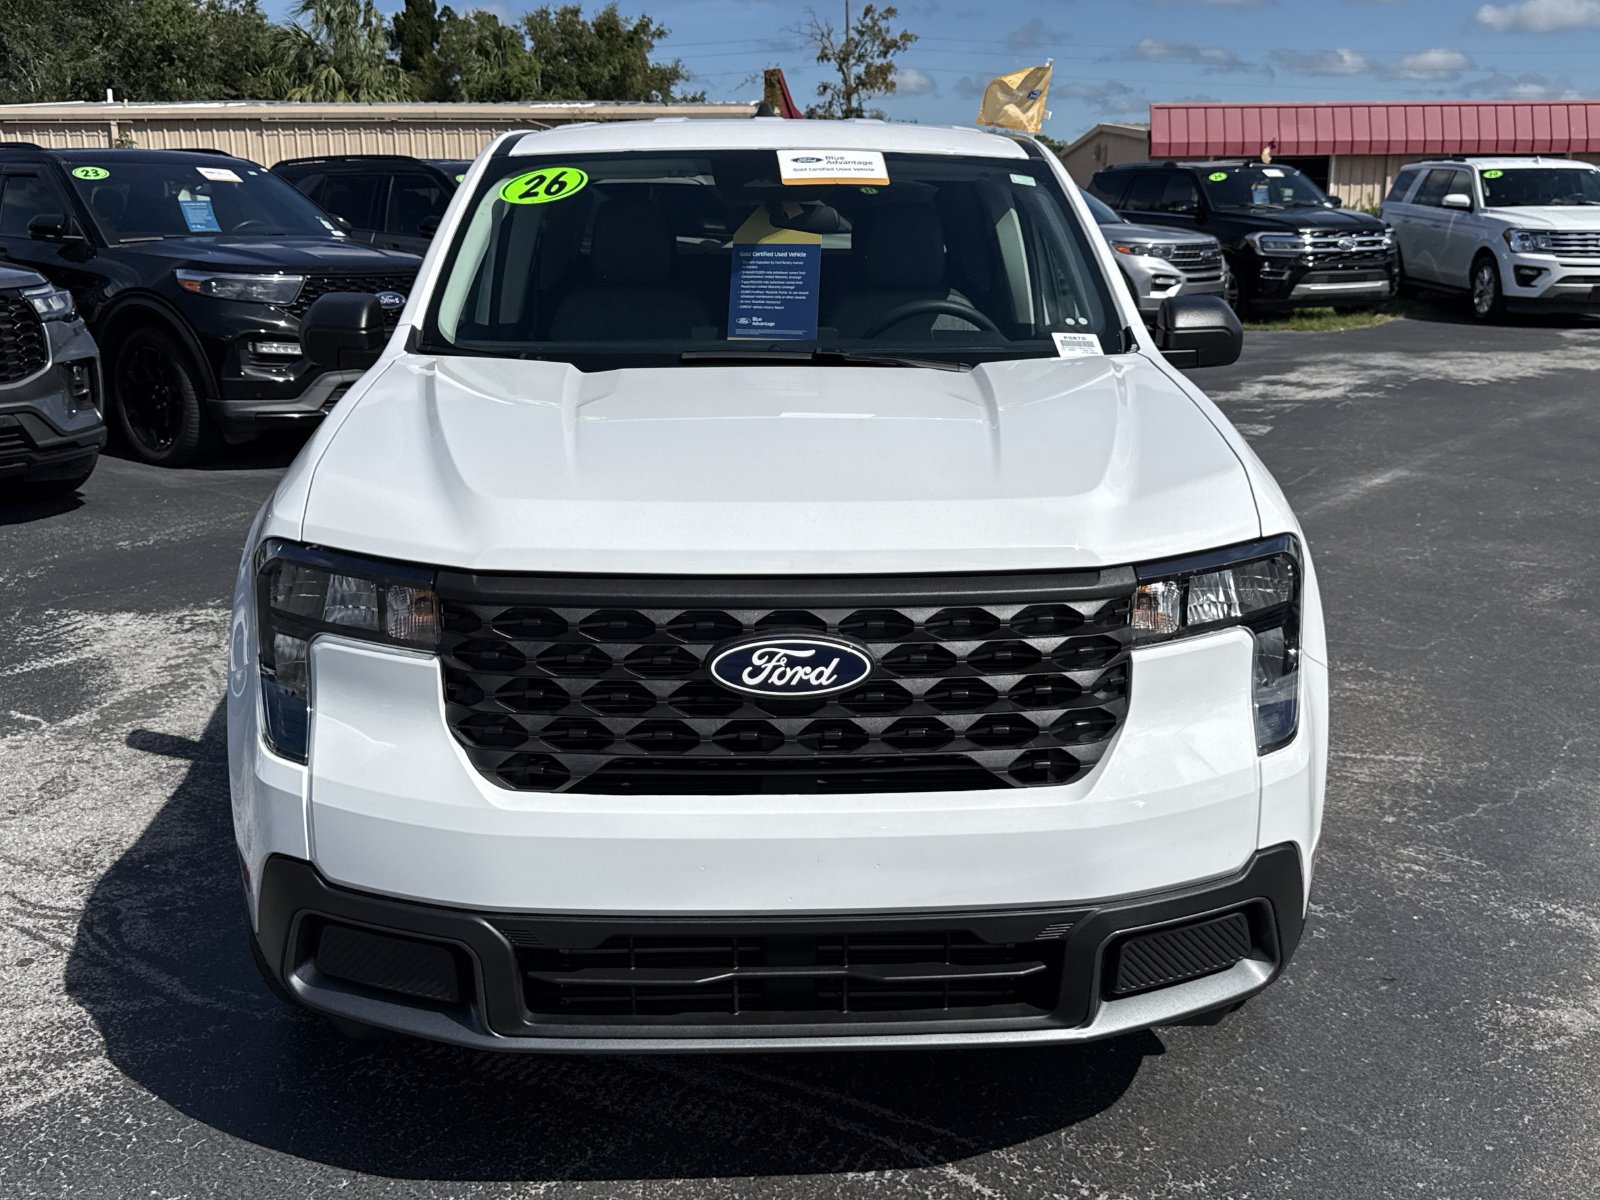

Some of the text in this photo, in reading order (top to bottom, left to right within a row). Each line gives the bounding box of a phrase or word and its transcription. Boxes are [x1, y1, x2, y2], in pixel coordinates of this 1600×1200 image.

[80, 169, 101, 178] 23
[517, 170, 568, 200] 26
[741, 647, 841, 686] Ford
